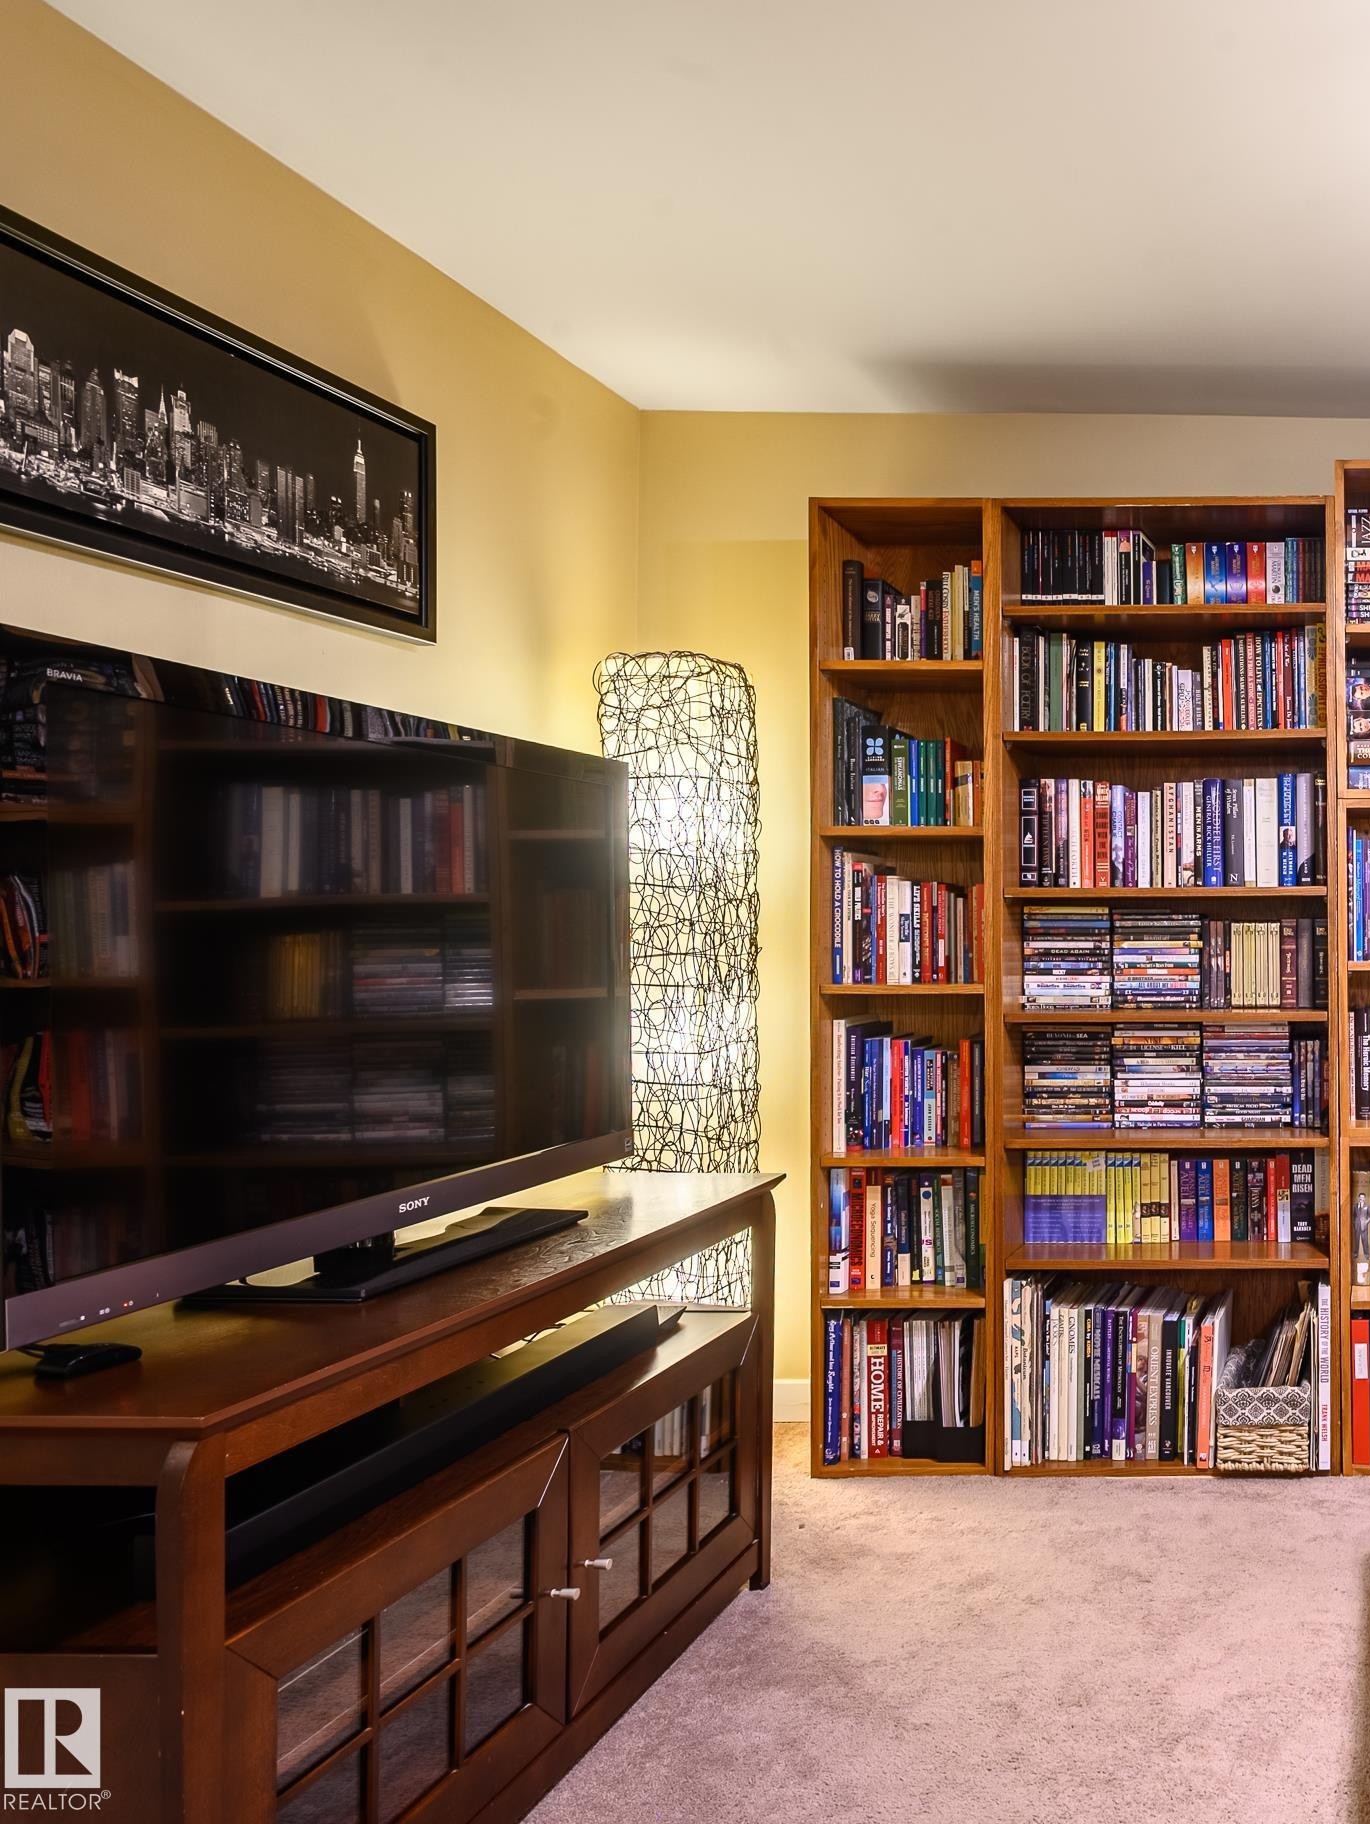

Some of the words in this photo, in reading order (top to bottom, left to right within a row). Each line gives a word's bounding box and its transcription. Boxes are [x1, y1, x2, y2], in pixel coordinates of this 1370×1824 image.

[1255, 657, 1262, 666] TO
[46, 668, 83, 682] BRAVIA
[1318, 653, 1326, 706] PHILOSOPHY
[1213, 801, 1221, 844] SOLDIER
[1213, 846, 1221, 872] FIRST
[834, 868, 841, 879] TO
[1362, 1034, 1370, 1043] The
[1362, 1067, 1370, 1091] Memory
[1292, 1164, 1312, 1174] DEAD
[1294, 1174, 1310, 1183] MEN
[1199, 1174, 1207, 1195] AUEL
[1292, 1183, 1312, 1193] RISEN
[399, 1196, 430, 1213] SONY
[1068, 1316, 1076, 1354] GNOMES
[1320, 1308, 1329, 1339] HISTORY
[1093, 1329, 1101, 1356] MOVIE
[1150, 1346, 1159, 1383] ORIENT
[1320, 1357, 1329, 1383] WORLD
[871, 1357, 884, 1412] HOME
[896, 1380, 902, 1389] OF
[1093, 1358, 1101, 1400] MUSICALS
[1149, 1385, 1158, 1426] EXPRESS
